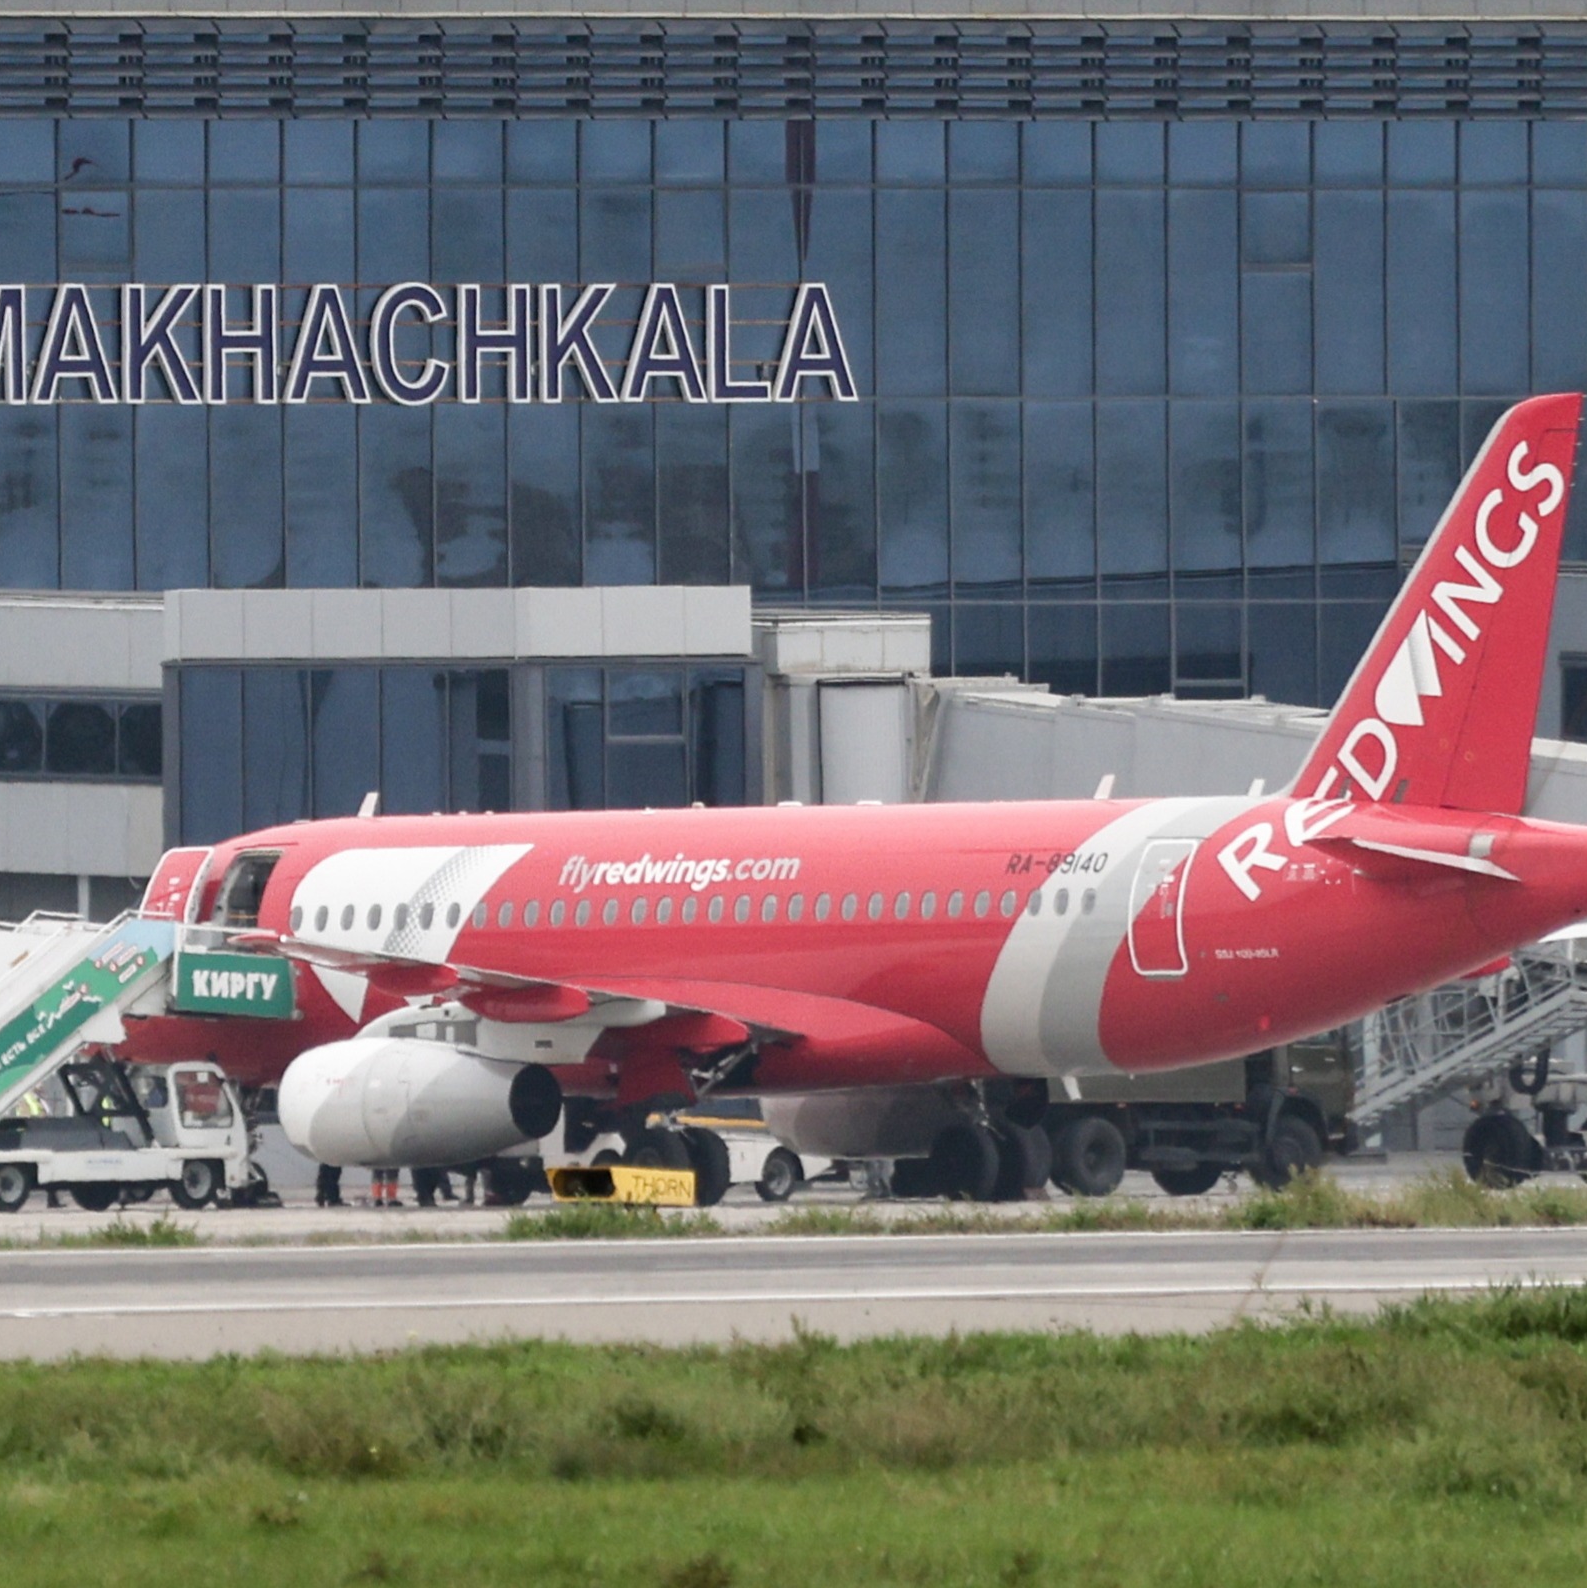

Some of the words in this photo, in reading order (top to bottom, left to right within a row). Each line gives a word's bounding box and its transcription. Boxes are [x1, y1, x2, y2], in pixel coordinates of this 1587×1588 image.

[558, 853, 801, 894] flyredwings.com
[1005, 852, 1109, 874] RA-89140
[192, 969, 278, 1001] КИРГУ
[0, 1041, 27, 1066] ЕСТЬ
[632, 1175, 692, 1199] THORN
